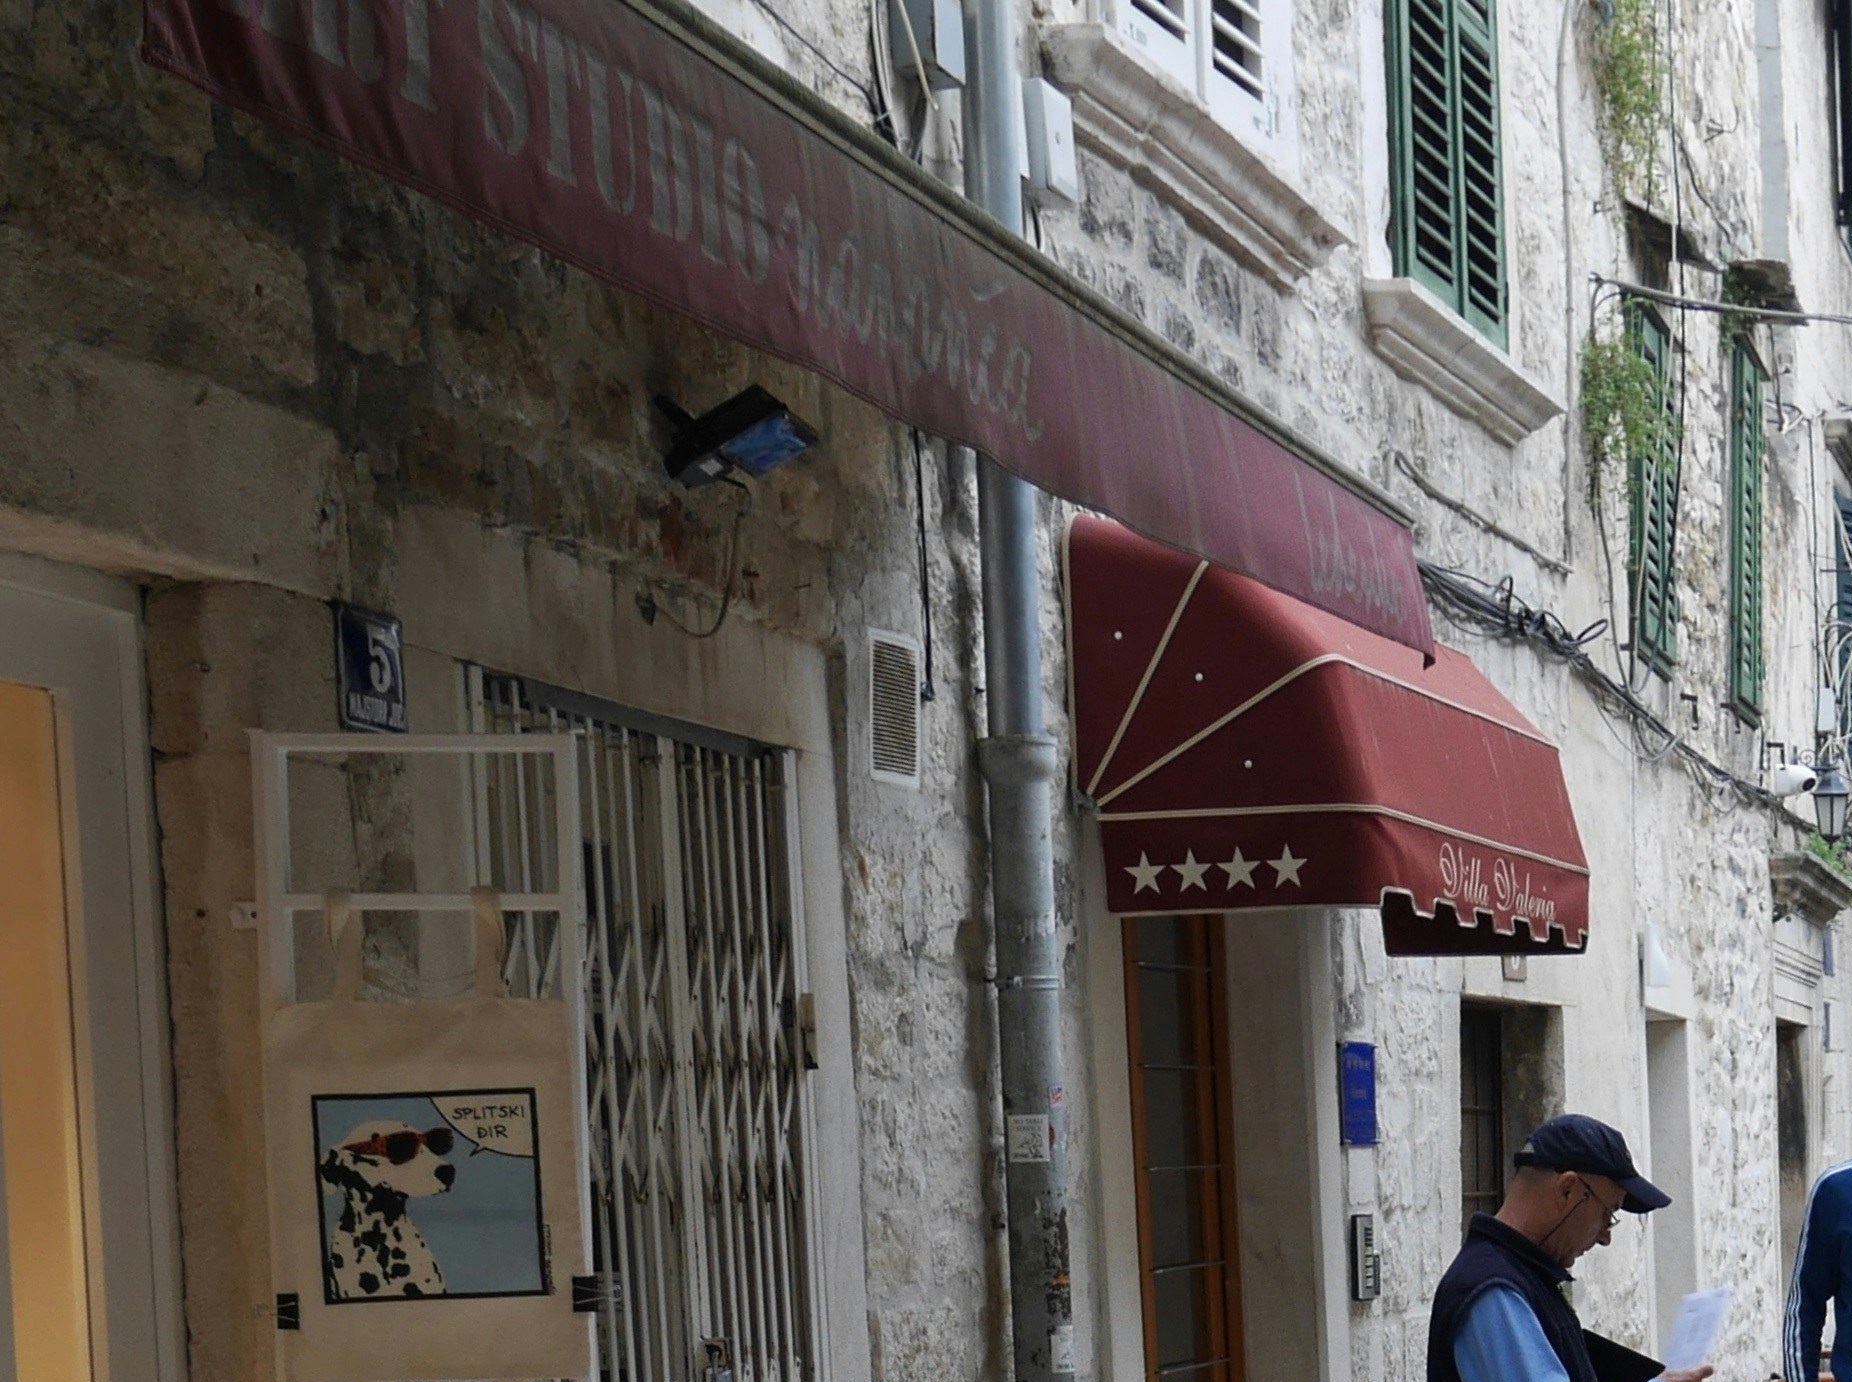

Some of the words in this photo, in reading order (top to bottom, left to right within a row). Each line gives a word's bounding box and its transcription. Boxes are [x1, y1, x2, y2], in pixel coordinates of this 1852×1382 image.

[365, 621, 398, 693] 5
[1439, 842, 1490, 906] Villa
[1494, 857, 1557, 921] Valeria
[452, 1104, 526, 1120] SPLITSKI
